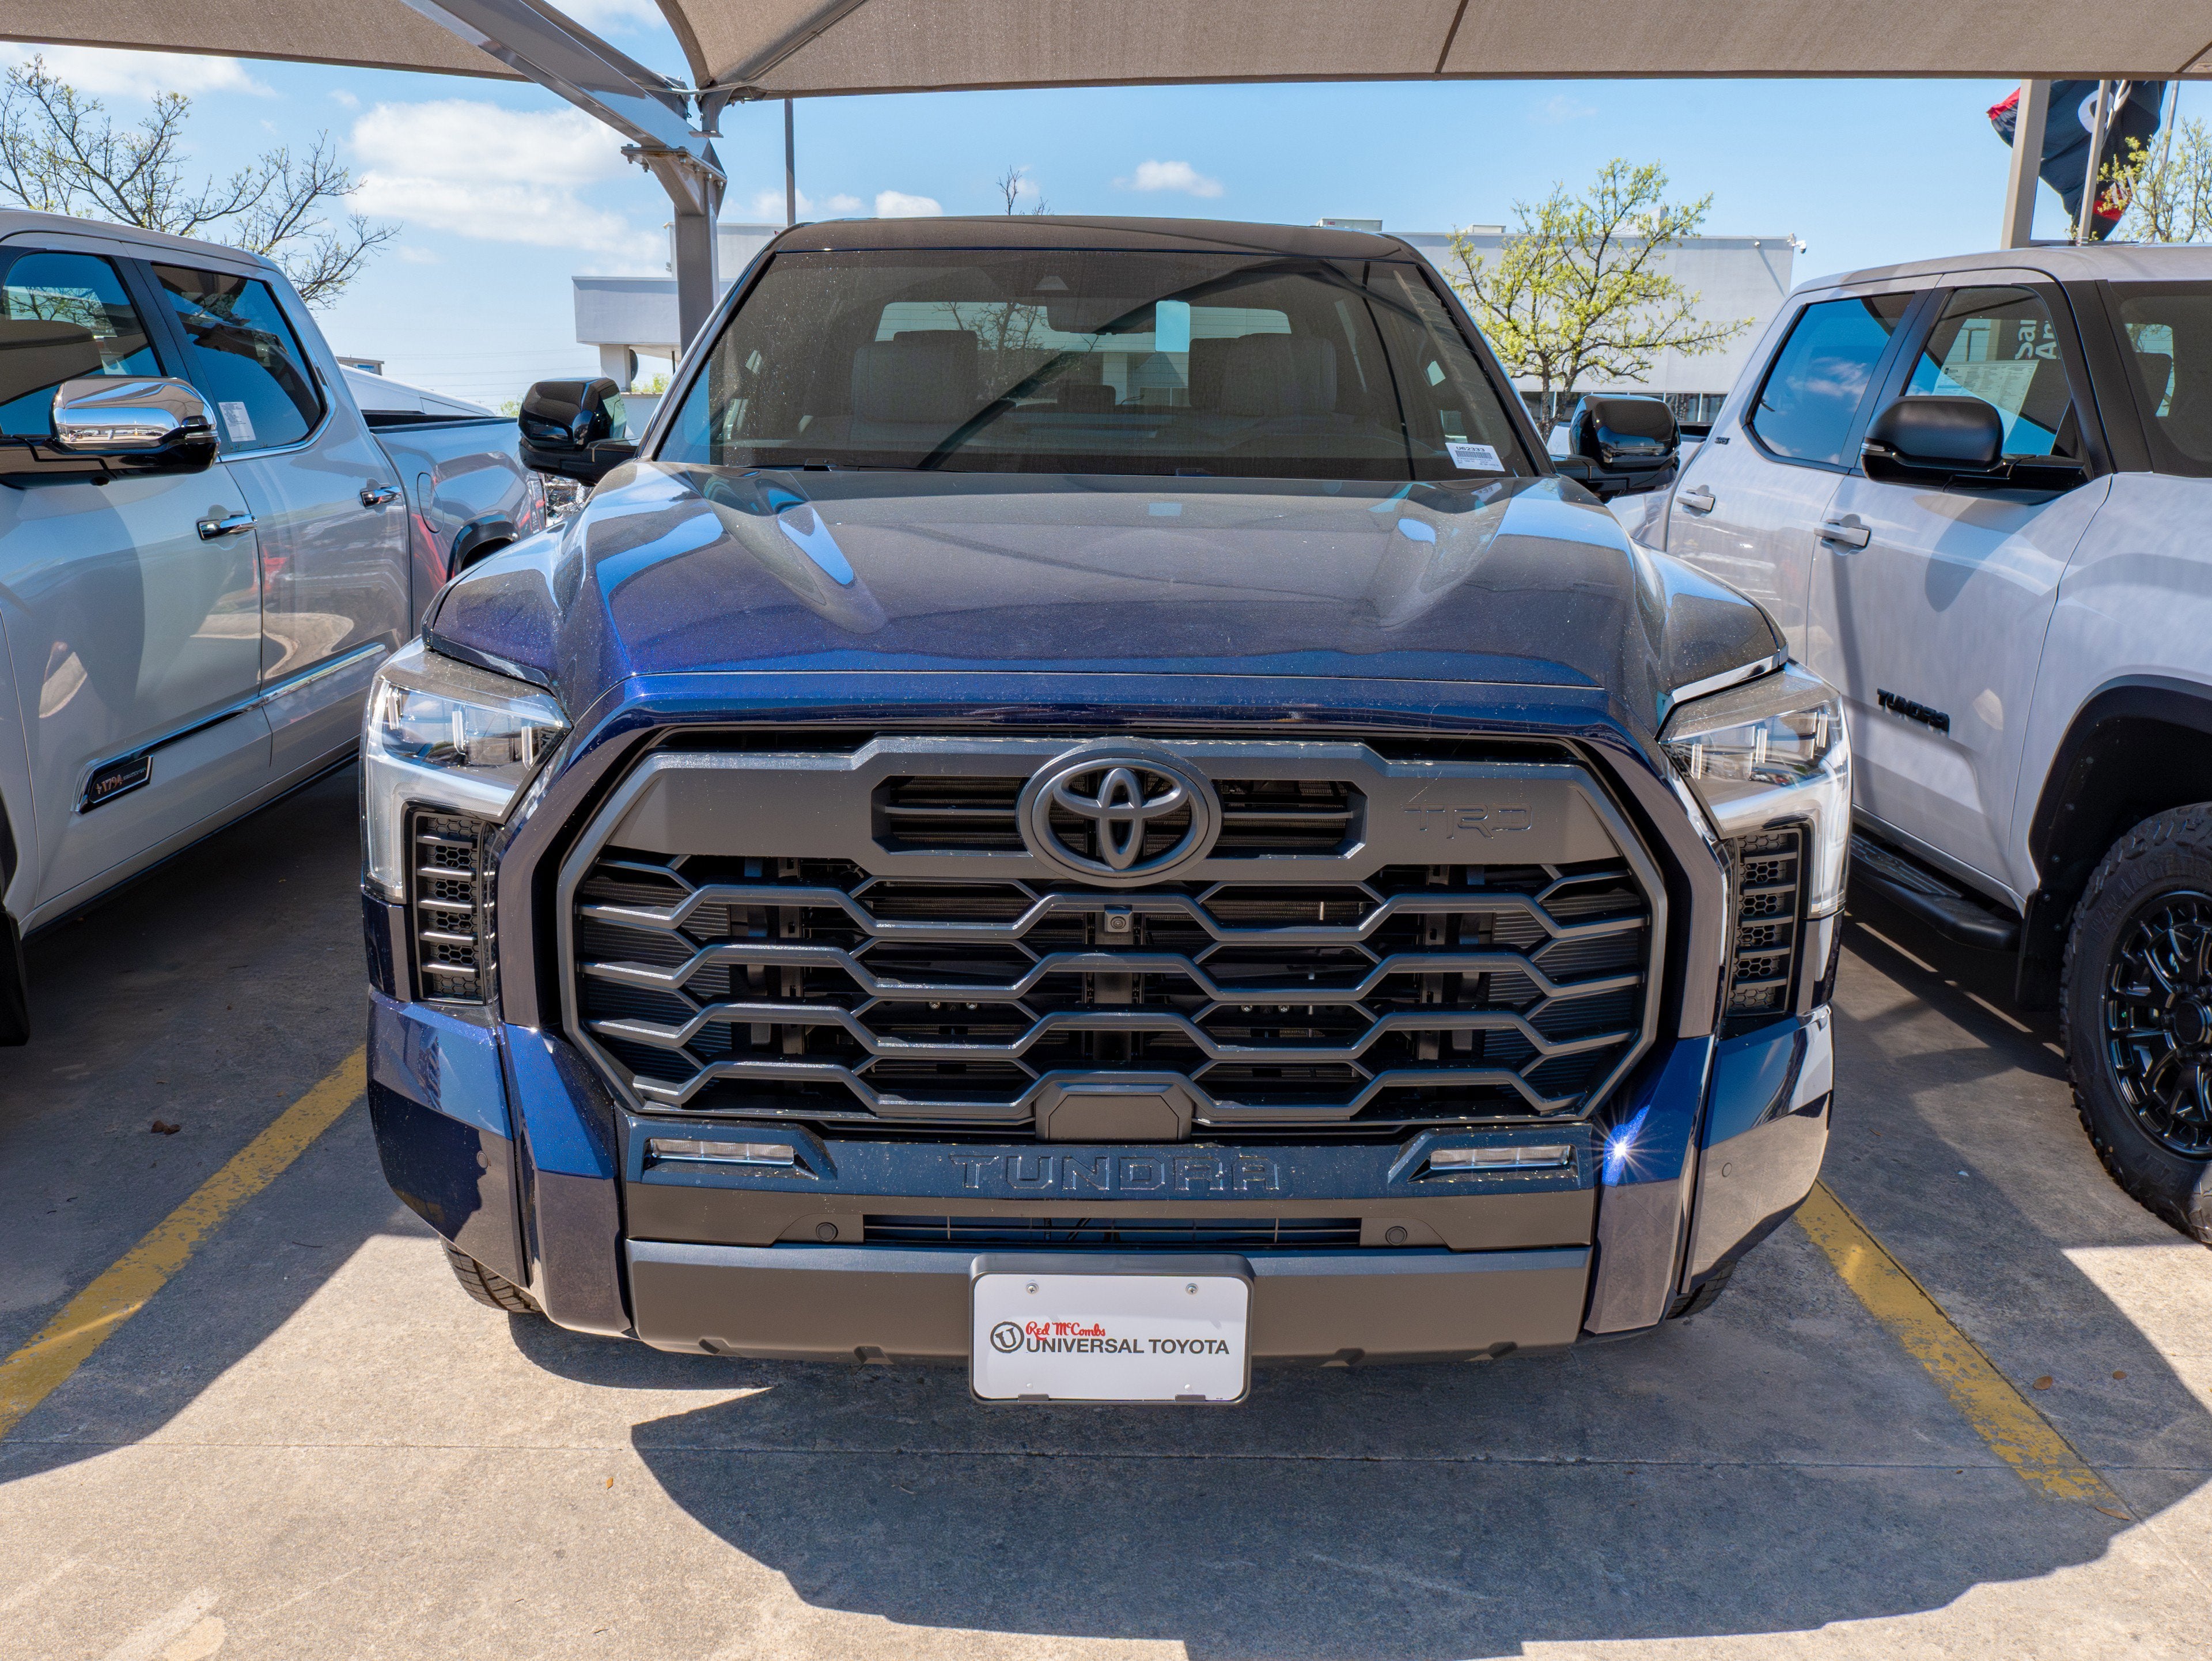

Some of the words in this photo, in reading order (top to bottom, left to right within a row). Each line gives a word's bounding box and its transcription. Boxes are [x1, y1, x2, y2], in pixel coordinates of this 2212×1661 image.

[1877, 688, 1950, 733] TUNDRA
[1402, 803, 1533, 839] TRD
[948, 1153, 1279, 1191] TUNDRA
[1025, 1321, 1050, 1341] Red
[1051, 1322, 1106, 1337] McCombs
[1025, 1338, 1145, 1354] UNIVERSAL
[1148, 1339, 1230, 1354] TOYOTA
